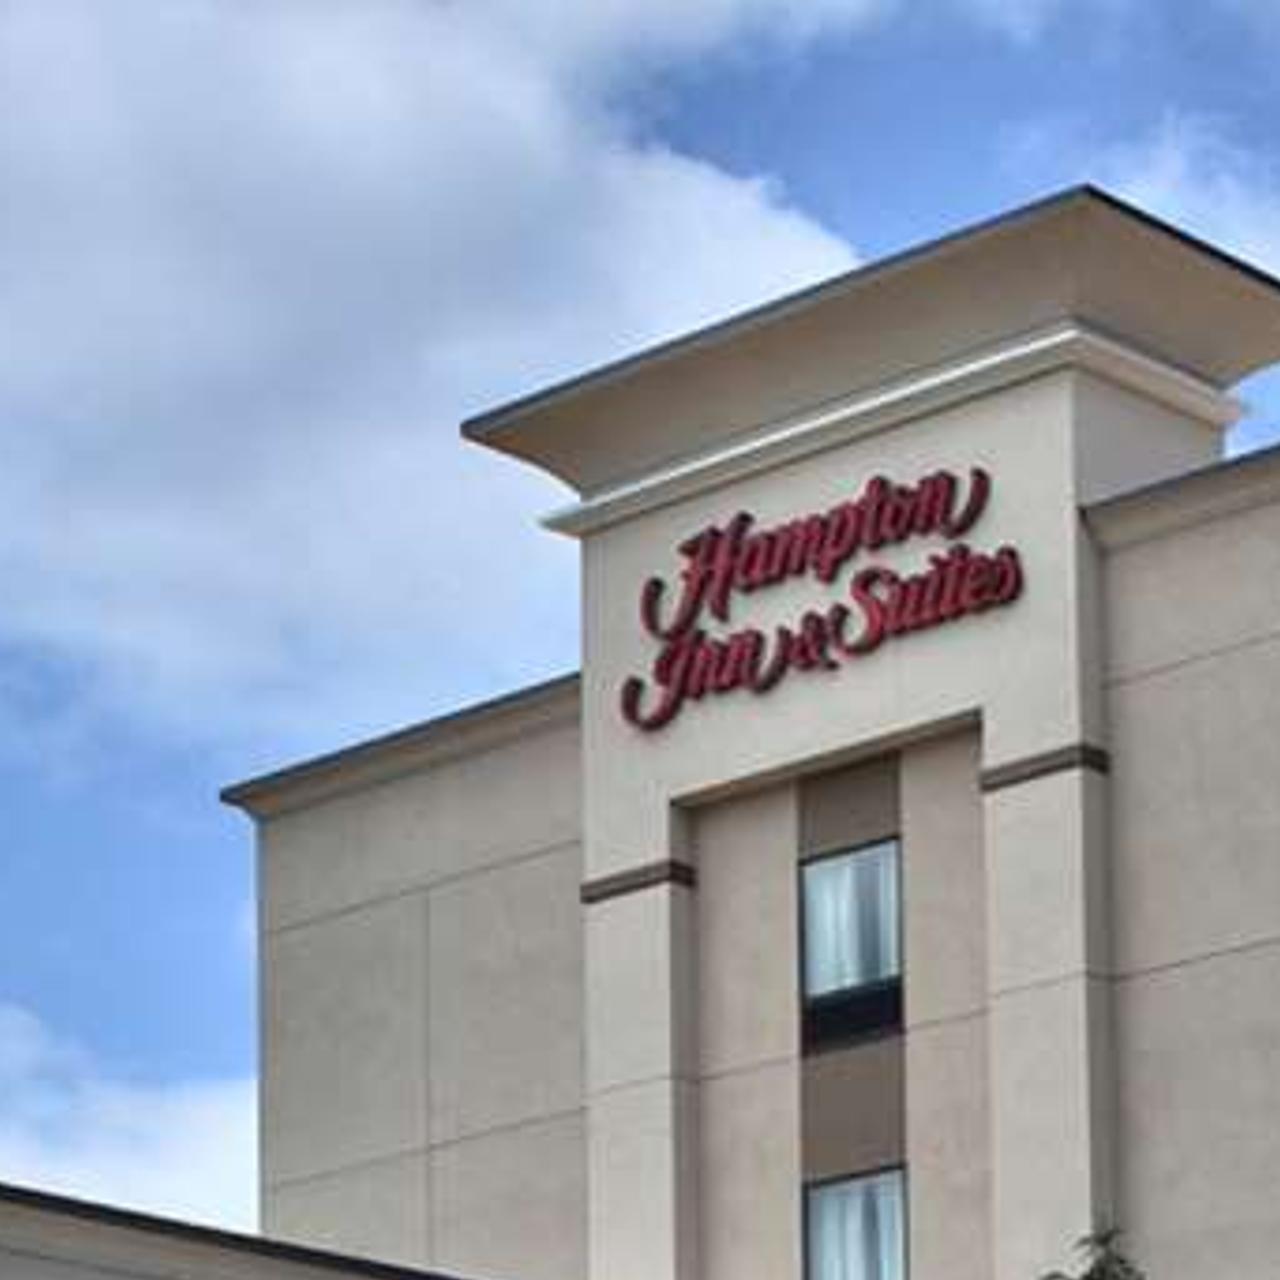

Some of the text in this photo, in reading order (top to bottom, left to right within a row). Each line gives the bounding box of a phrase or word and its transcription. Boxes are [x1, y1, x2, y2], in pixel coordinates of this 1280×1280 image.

[622, 543, 1024, 731] Inn & Suites
[641, 468, 991, 640] Hampton
